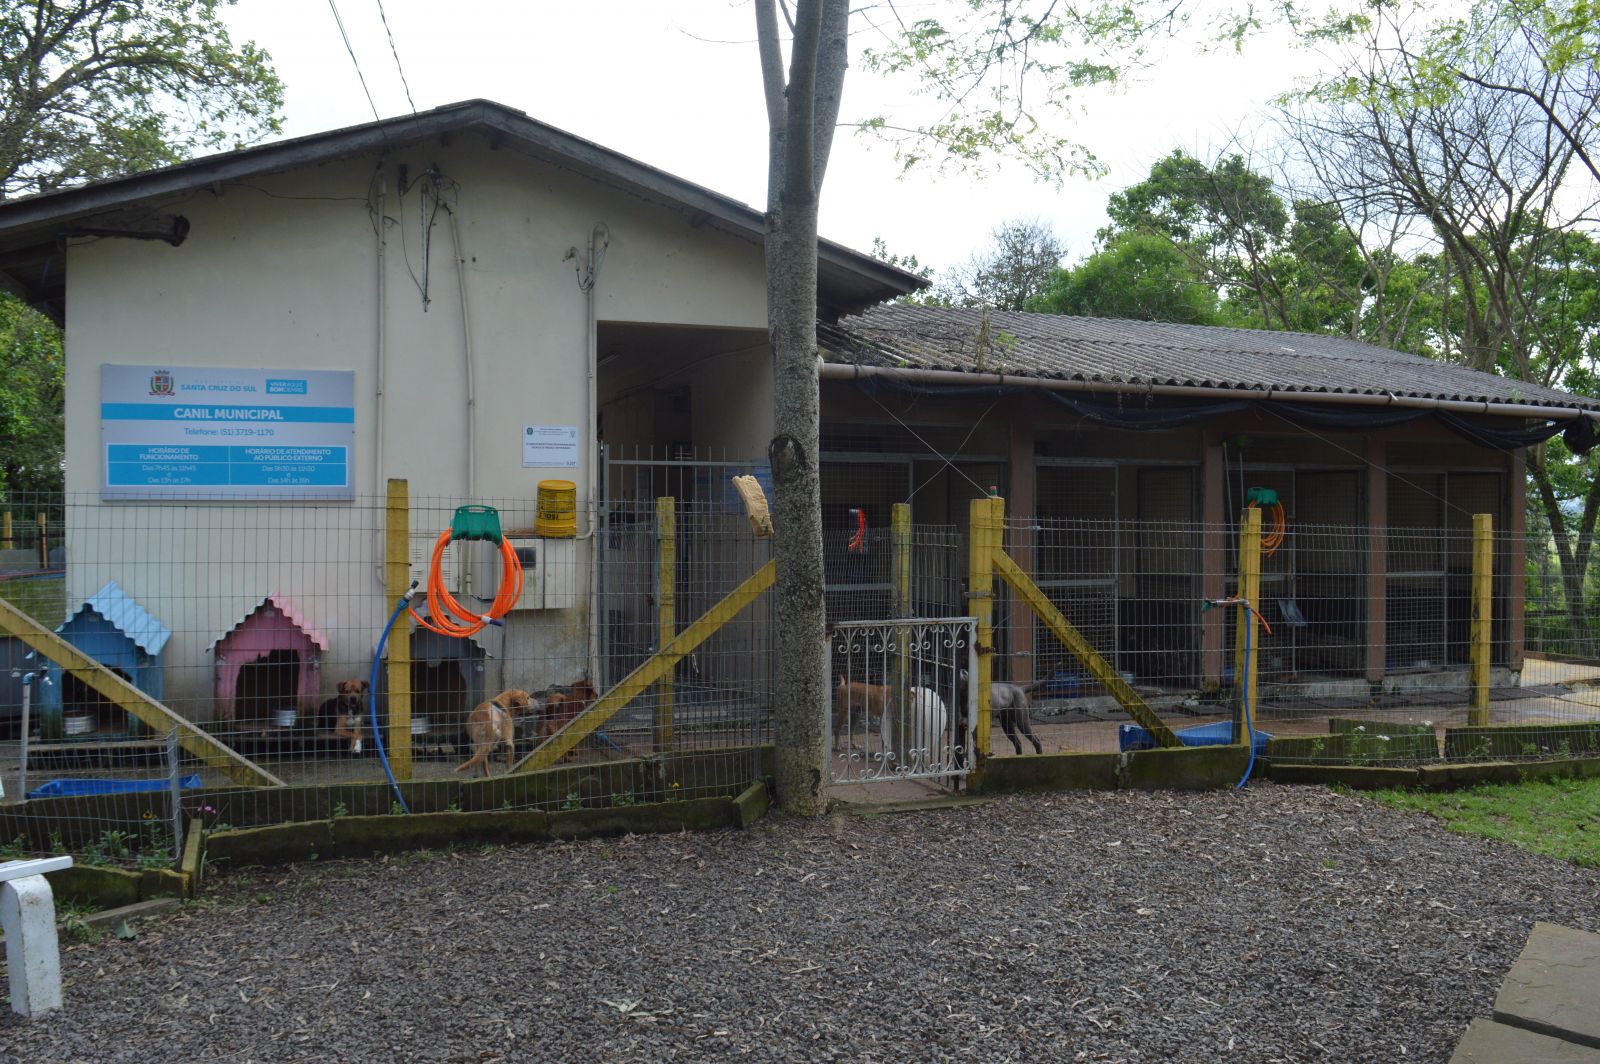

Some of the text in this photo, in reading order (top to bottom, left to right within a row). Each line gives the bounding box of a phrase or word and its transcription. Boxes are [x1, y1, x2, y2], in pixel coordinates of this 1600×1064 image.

[174, 408, 284, 420] CANIL MUNICIPAL
[184, 427, 275, 437] Telefone: (51) 3719-1170
